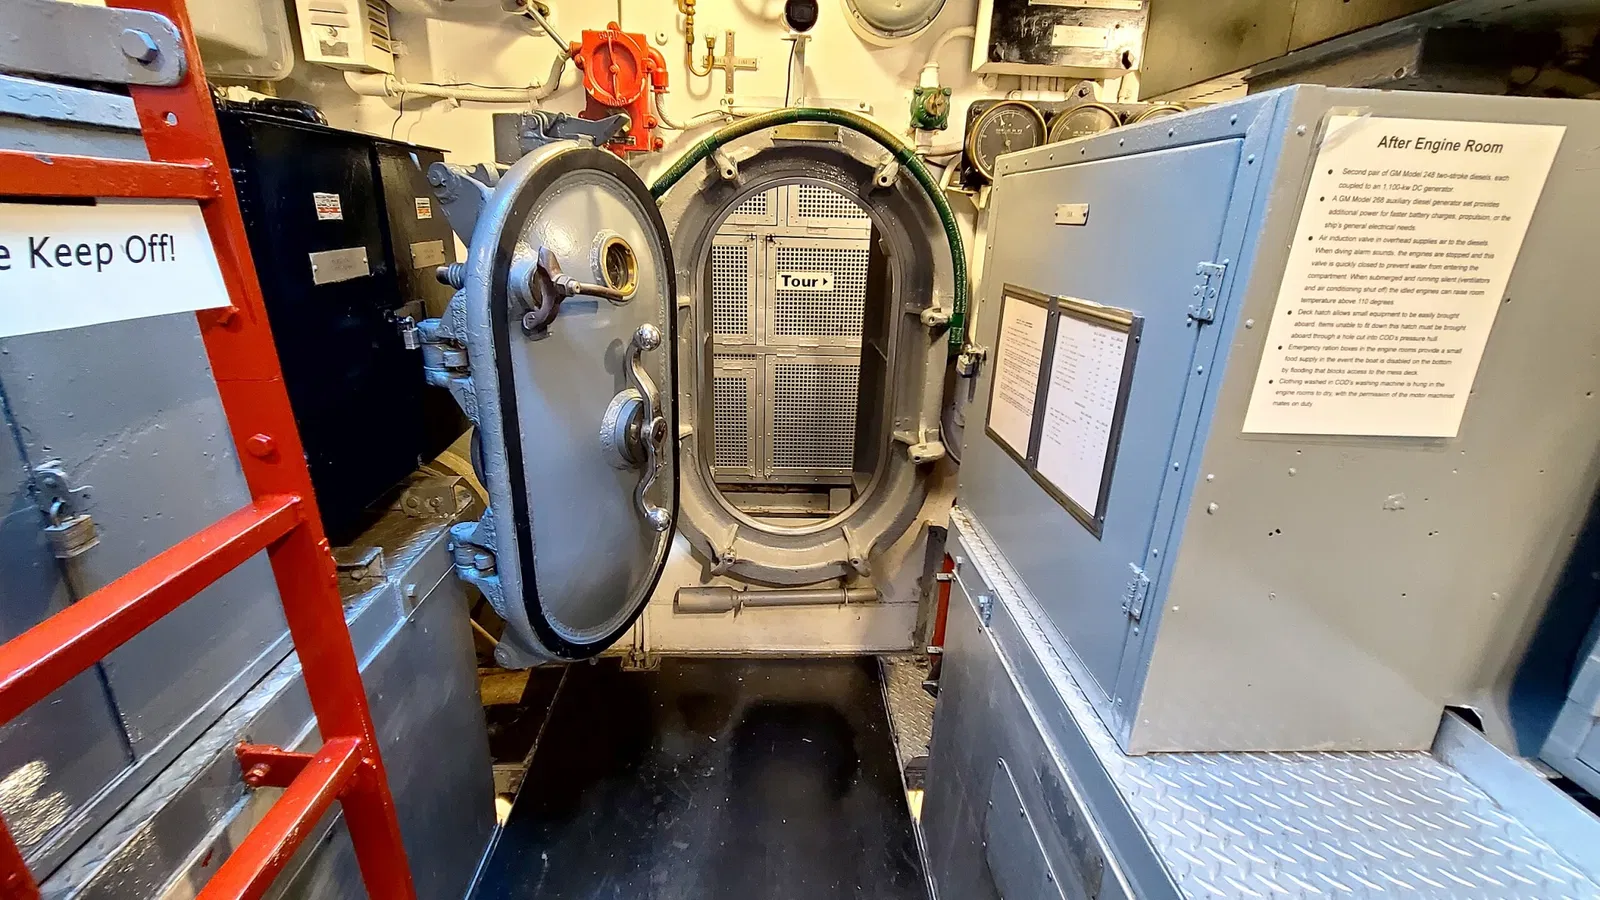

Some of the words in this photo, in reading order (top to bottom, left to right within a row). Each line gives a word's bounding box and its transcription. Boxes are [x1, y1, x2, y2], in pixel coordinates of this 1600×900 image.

[1376, 135, 1412, 149] After
[1414, 136, 1461, 154] Engine
[1463, 139, 1503, 153] Room
[1341, 167, 1367, 175] Second
[1381, 168, 1389, 176] of
[1389, 169, 1402, 177] GM
[1401, 170, 1422, 178] Model
[1338, 182, 1364, 190] coupled
[1411, 183, 1423, 192] DC
[1338, 194, 1351, 202] GM
[1351, 195, 1372, 203] Model
[1385, 197, 1412, 206] auxiliary
[1431, 199, 1462, 207] generator
[1327, 208, 1359, 216] additional
[1379, 209, 1389, 217] for
[1408, 211, 1430, 220] battery
[1324, 221, 1342, 229] ship's
[1342, 222, 1367, 230] general
[28, 235, 113, 272] Keep
[125, 233, 175, 264] Off!
[1315, 246, 1333, 254] When
[1333, 247, 1353, 256] diving
[1442, 264, 1468, 272] entering
[781, 274, 819, 288] Tour
[1368, 274, 1403, 282] submerged
[1416, 276, 1440, 284] running
[1325, 285, 1362, 294] conditioning
[1436, 312, 1460, 320] brought
[1443, 324, 1467, 332] brought
[1287, 343, 1321, 352] Emergency
[1290, 366, 1313, 374] flooding
[1278, 377, 1303, 386] Clothing
